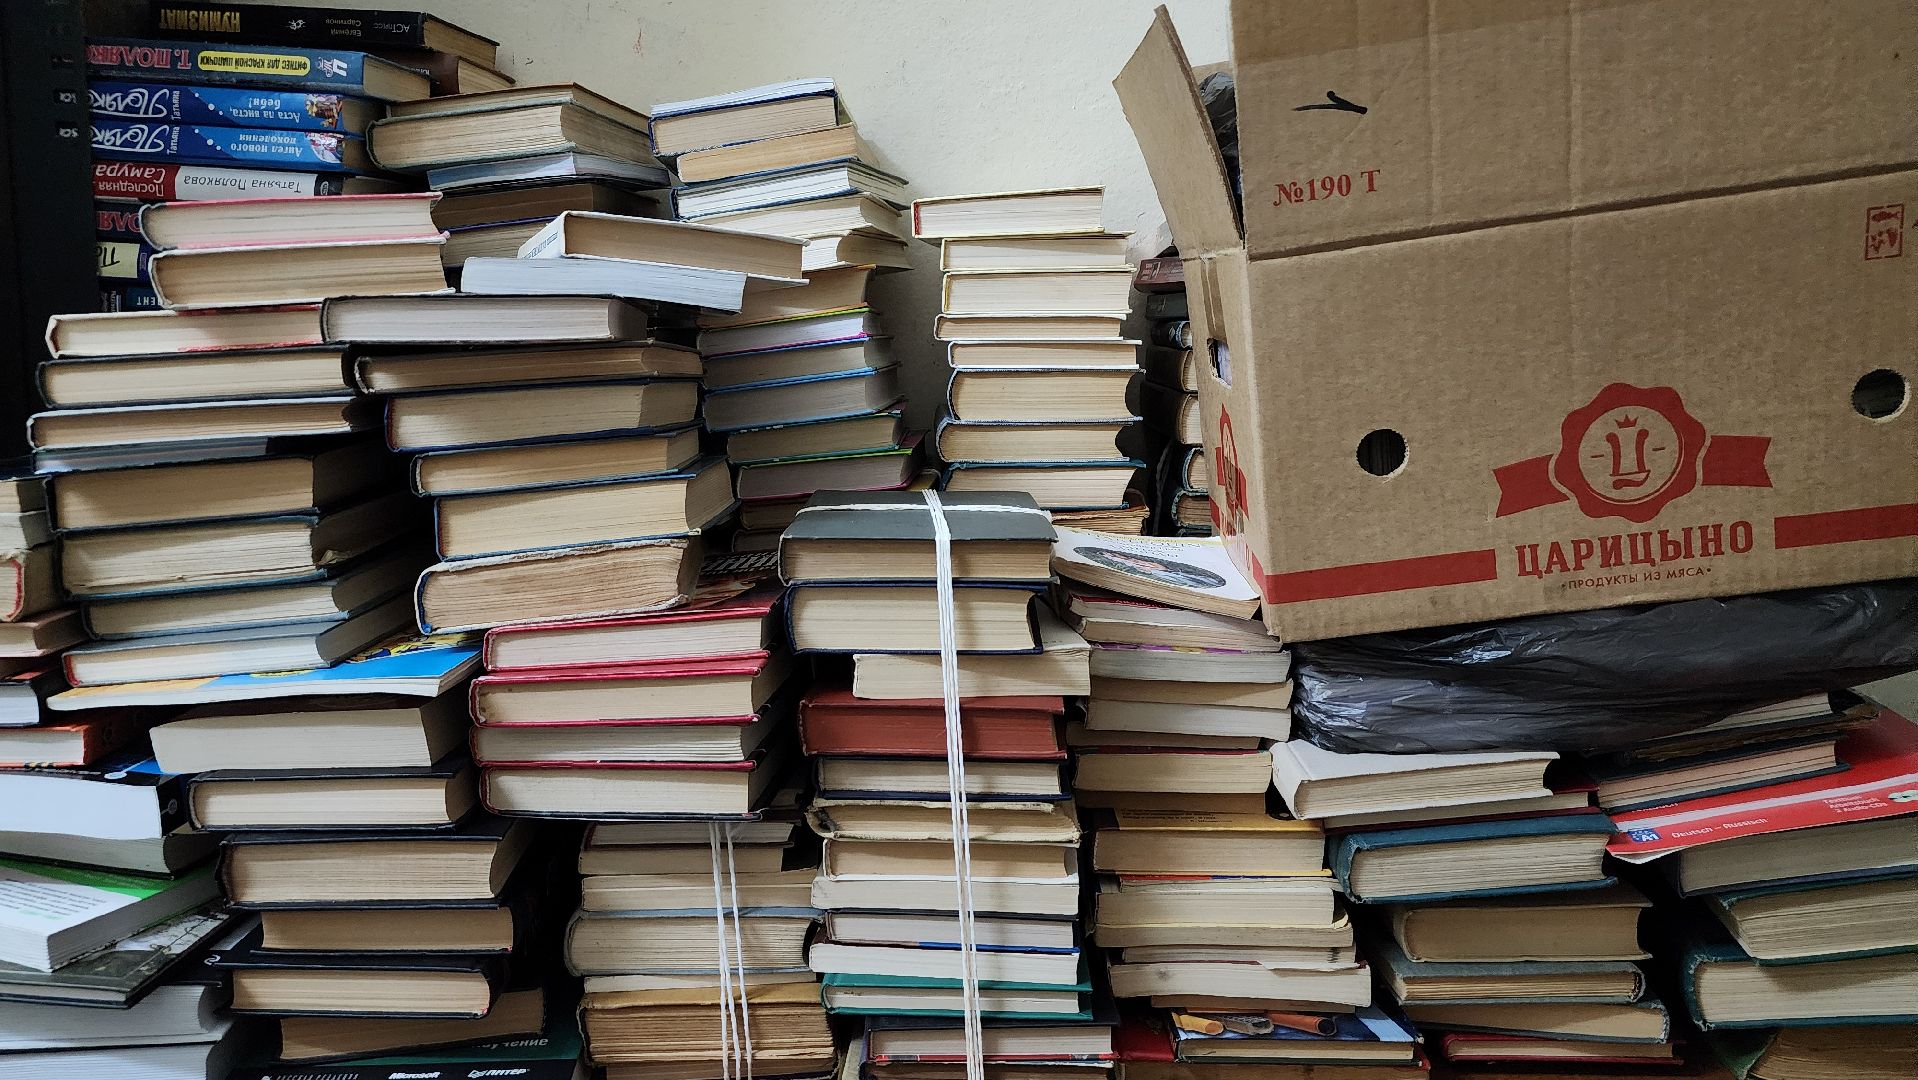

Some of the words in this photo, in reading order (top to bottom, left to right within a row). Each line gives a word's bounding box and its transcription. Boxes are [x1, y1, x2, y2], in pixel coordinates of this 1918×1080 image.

[159, 9, 241, 33] НУМИЗМАТ
[174, 49, 192, 70] Т.
[199, 56, 234, 67] ШАПОЧКИ
[234, 57, 266, 70] КРАСНОЙ
[267, 59, 281, 70] ДЛЯ
[281, 61, 308, 71] ФИТНЕС
[248, 97, 281, 110] беби!
[279, 112, 301, 123] Аста
[167, 126, 181, 155] Татьяна
[239, 133, 297, 144] поколения
[230, 143, 268, 153] нового
[269, 144, 303, 157] Ангел
[99, 181, 165, 197] Последняя
[183, 175, 246, 190] Полякова
[251, 180, 302, 194] Татьяна
[1515, 520, 1754, 579] ЦАРИЦЫНО
[1567, 573, 1638, 589] ПРОДУКТЫ
[1644, 571, 1661, 582] ИЗ
[1666, 566, 1705, 579] МЯСА
[1671, 826, 1714, 838] Deutsch
[1723, 817, 1769, 829] Russisch
[1641, 832, 1660, 842] A1
[388, 1071, 441, 1080] Microsoft
[484, 1068, 528, 1077] ПИТЕР
